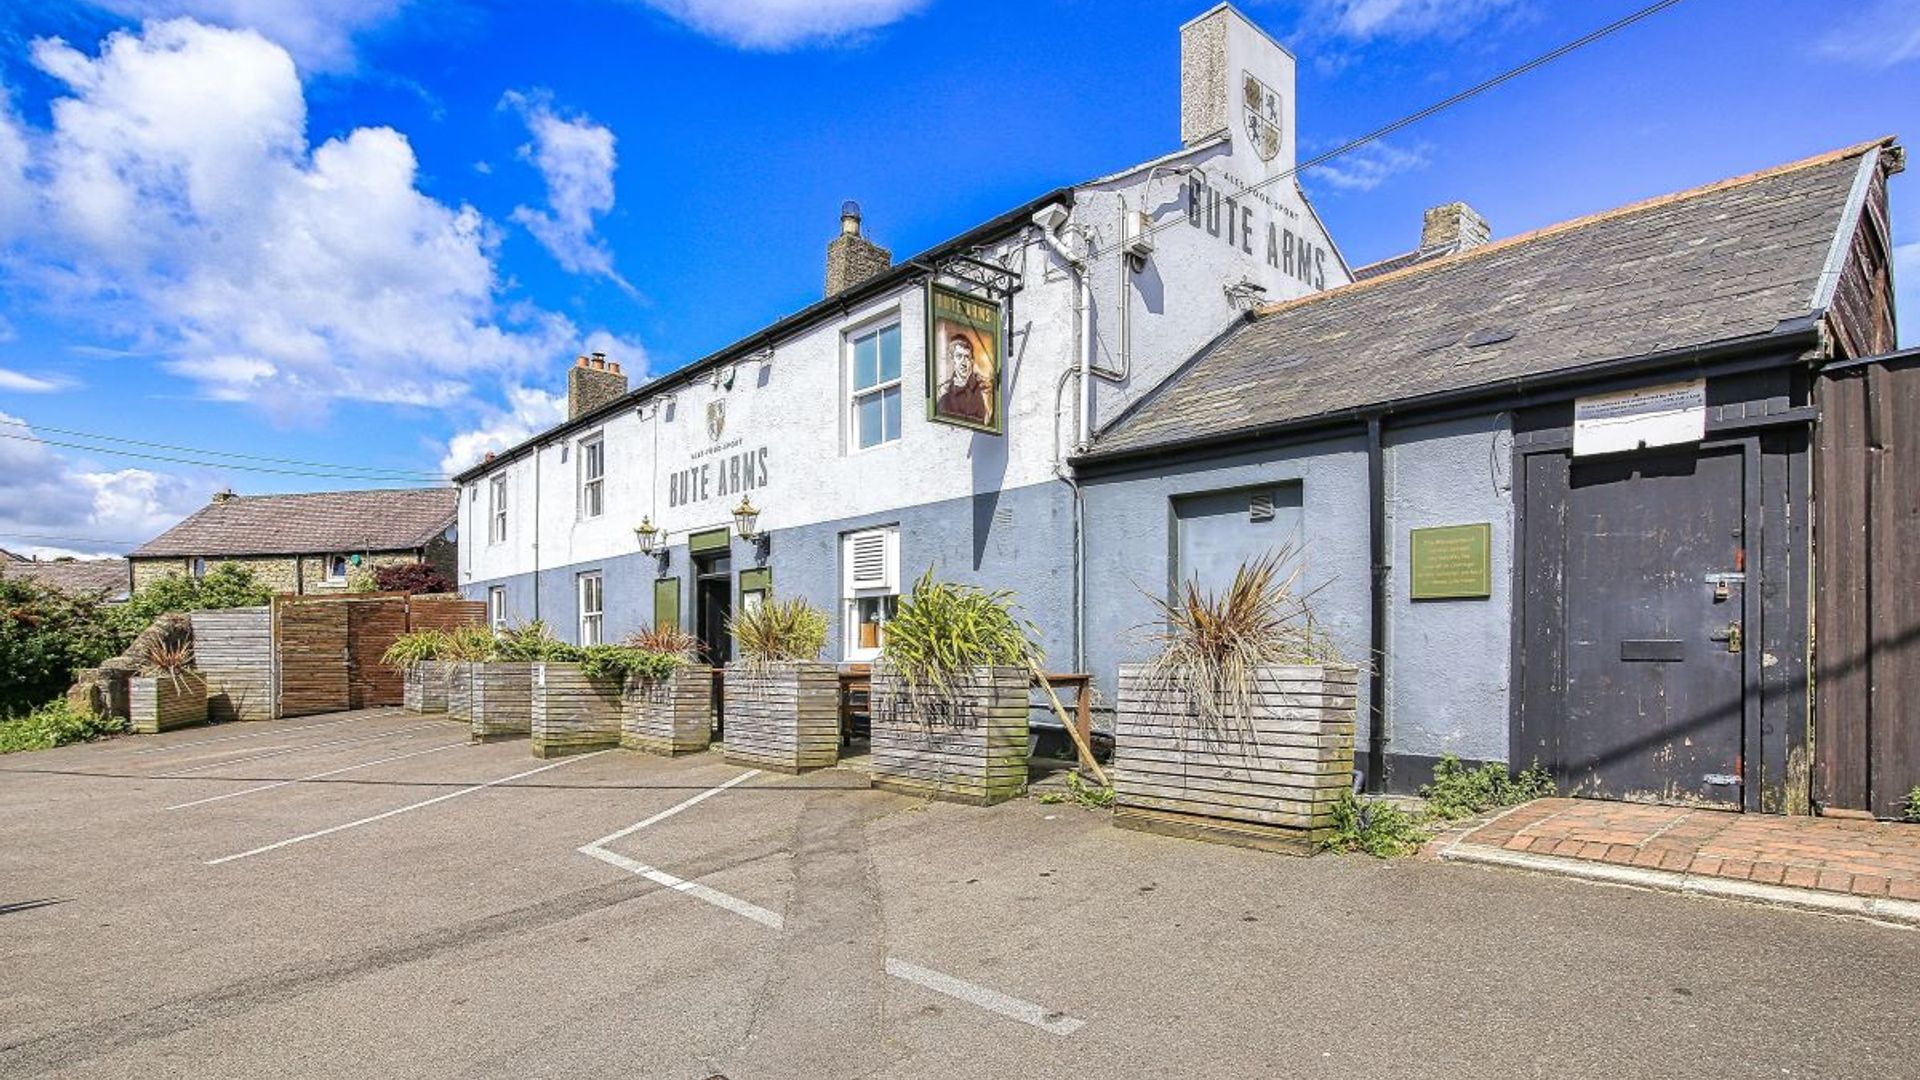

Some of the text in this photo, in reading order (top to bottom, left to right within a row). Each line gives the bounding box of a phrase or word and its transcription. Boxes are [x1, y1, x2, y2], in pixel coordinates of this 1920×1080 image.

[1189, 175, 1325, 291] BUTE ARMS
[669, 446, 768, 508] BUTE ARMS
